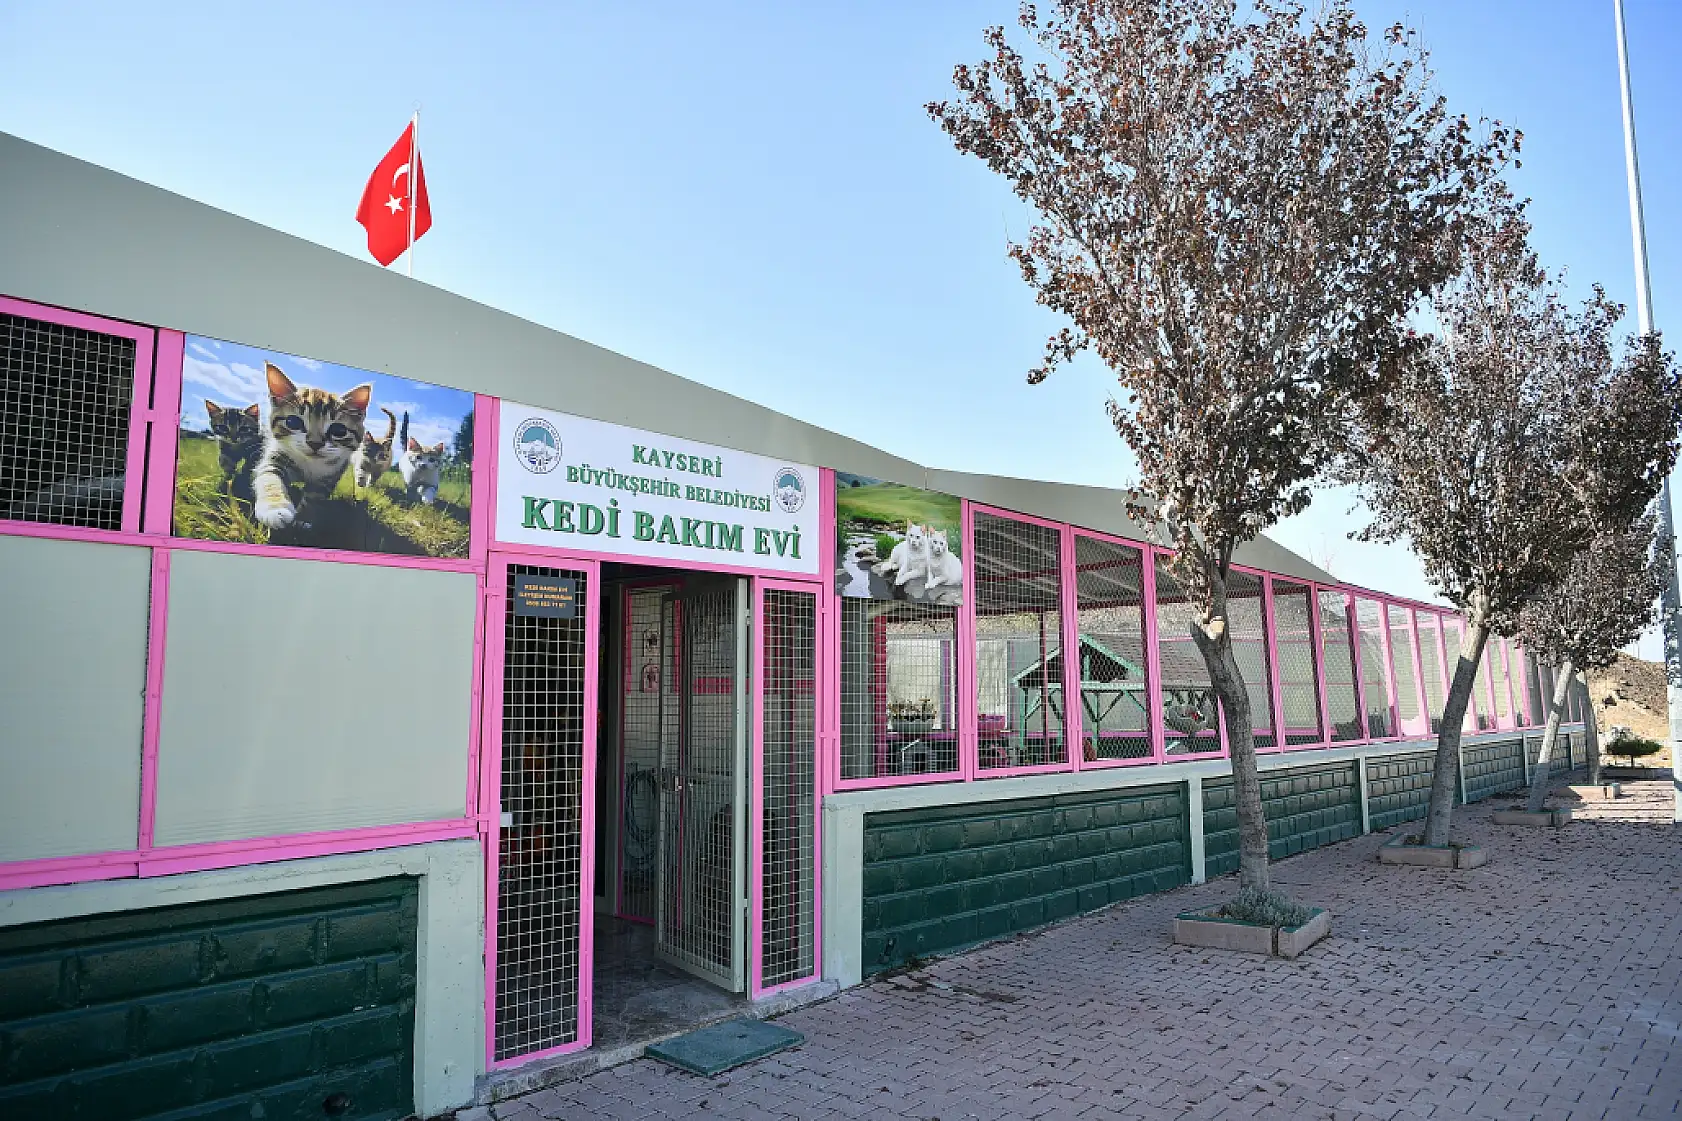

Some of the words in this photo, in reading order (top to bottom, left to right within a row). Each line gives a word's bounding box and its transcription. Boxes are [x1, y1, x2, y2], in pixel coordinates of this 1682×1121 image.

[632, 444, 723, 477] KAYSERİ
[566, 464, 681, 498] BÜYÜKŞEHİR
[685, 484, 771, 512] BELEDİYESİ
[521, 496, 622, 538] KEDİ
[632, 511, 744, 553] BAKIM
[753, 525, 802, 559] EVİ
